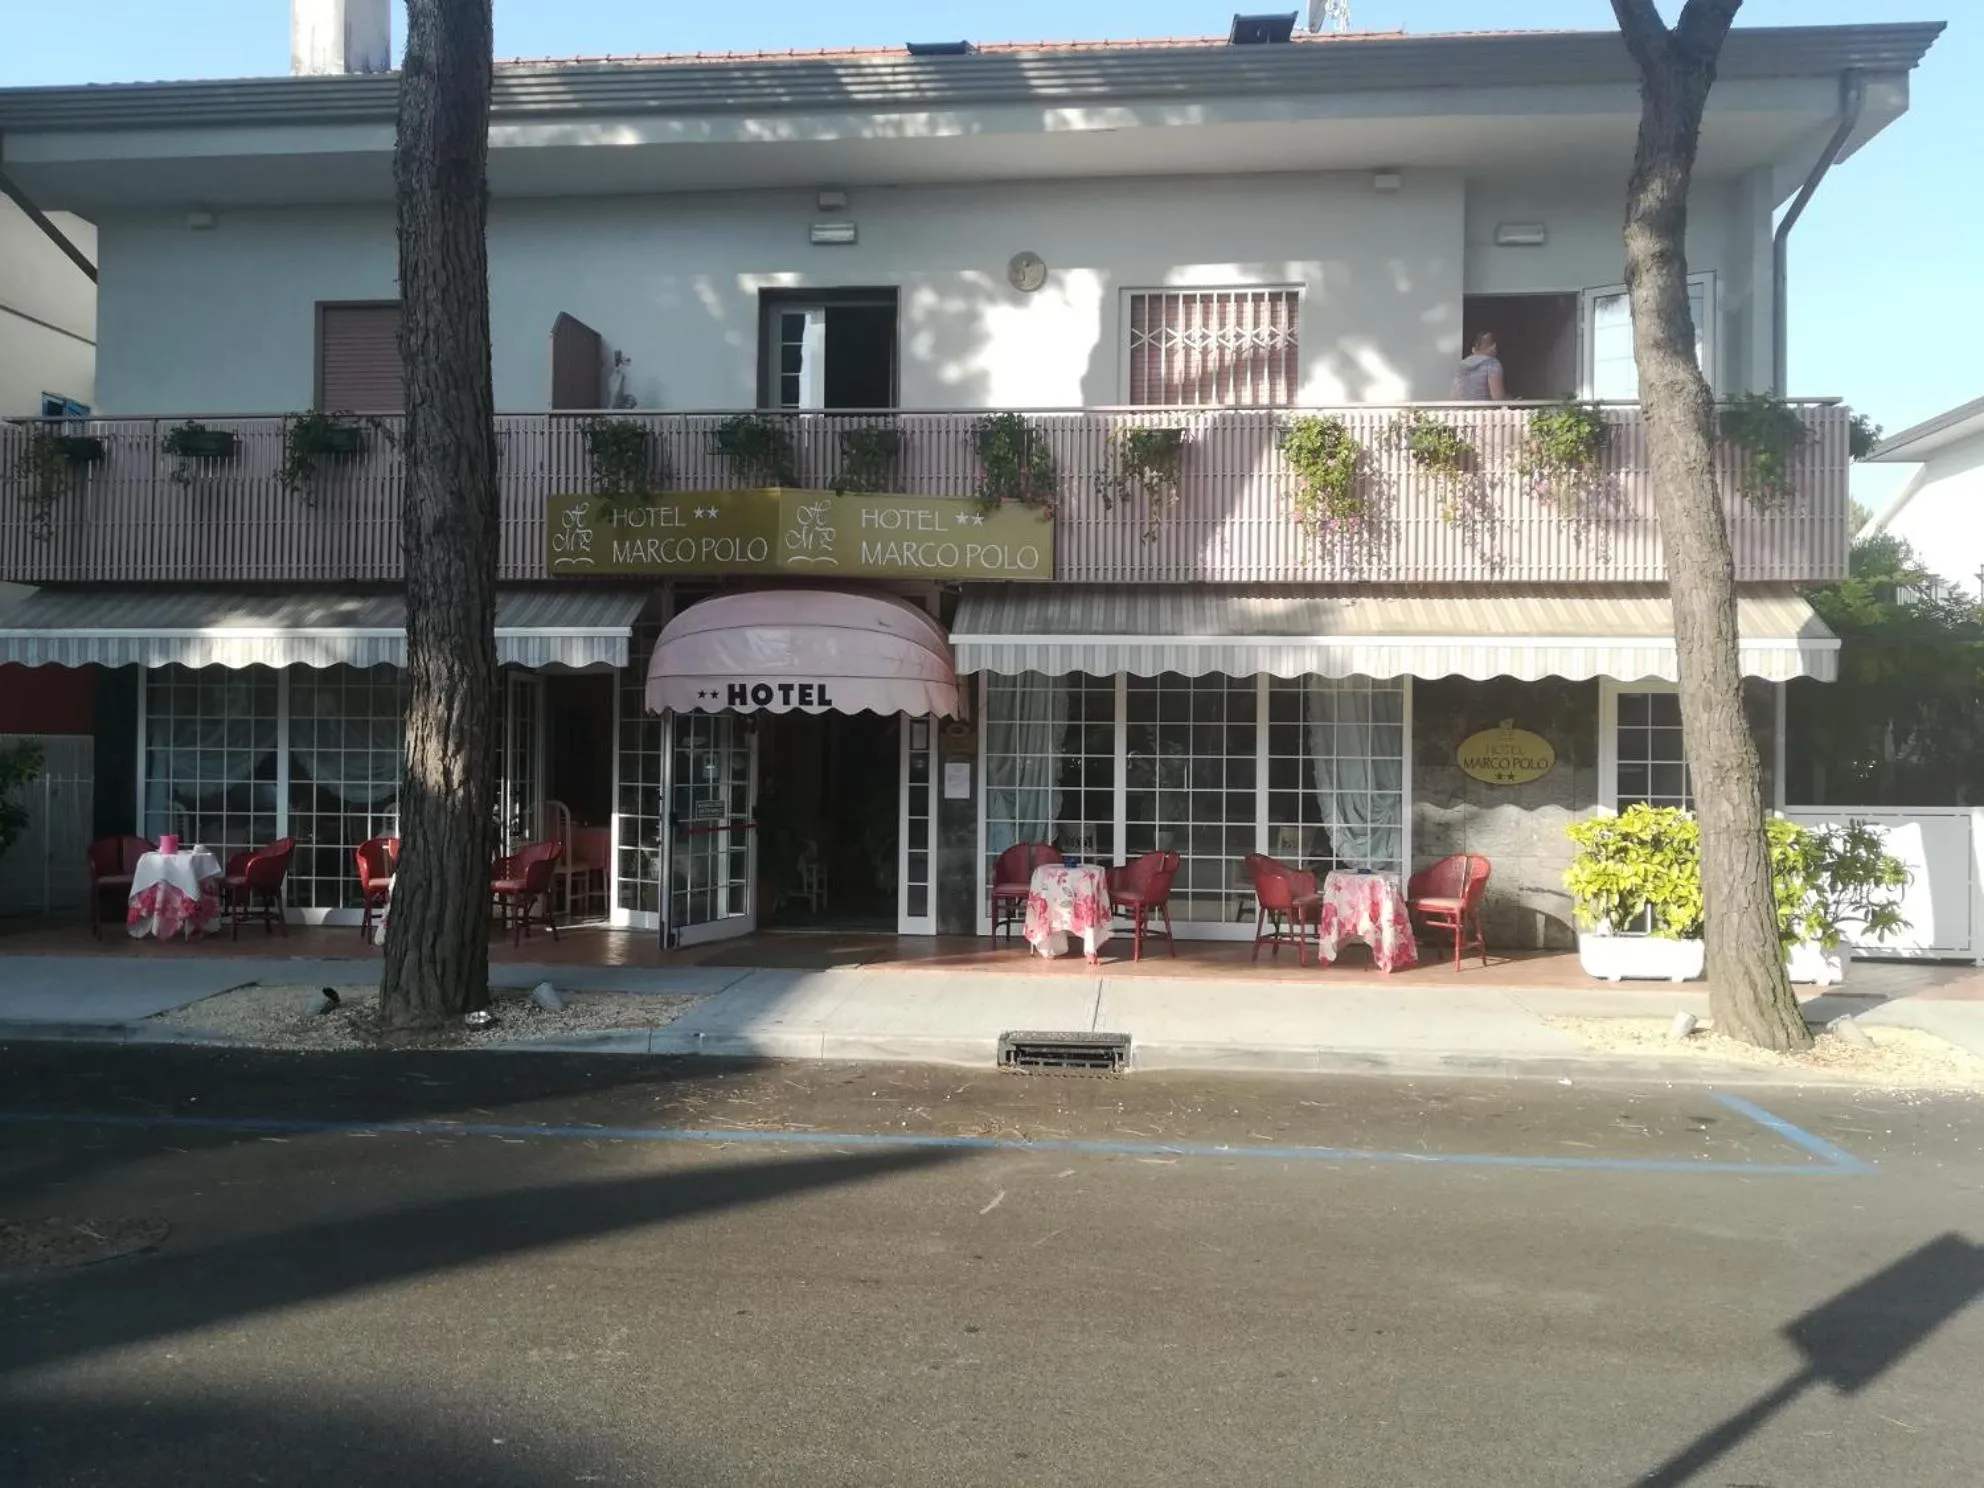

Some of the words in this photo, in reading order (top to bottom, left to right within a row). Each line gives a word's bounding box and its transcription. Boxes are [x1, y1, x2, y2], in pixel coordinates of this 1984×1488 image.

[612, 507, 687, 528] HOTEL
[861, 508, 948, 532] HOTEL
[612, 538, 696, 564] MARCO
[701, 536, 768, 563] POLO
[861, 541, 959, 568] MARCO
[966, 543, 1039, 570] POLO
[727, 683, 833, 706] HOTEL
[1463, 757, 1510, 770] MARCO
[1512, 757, 1549, 770] POLO
